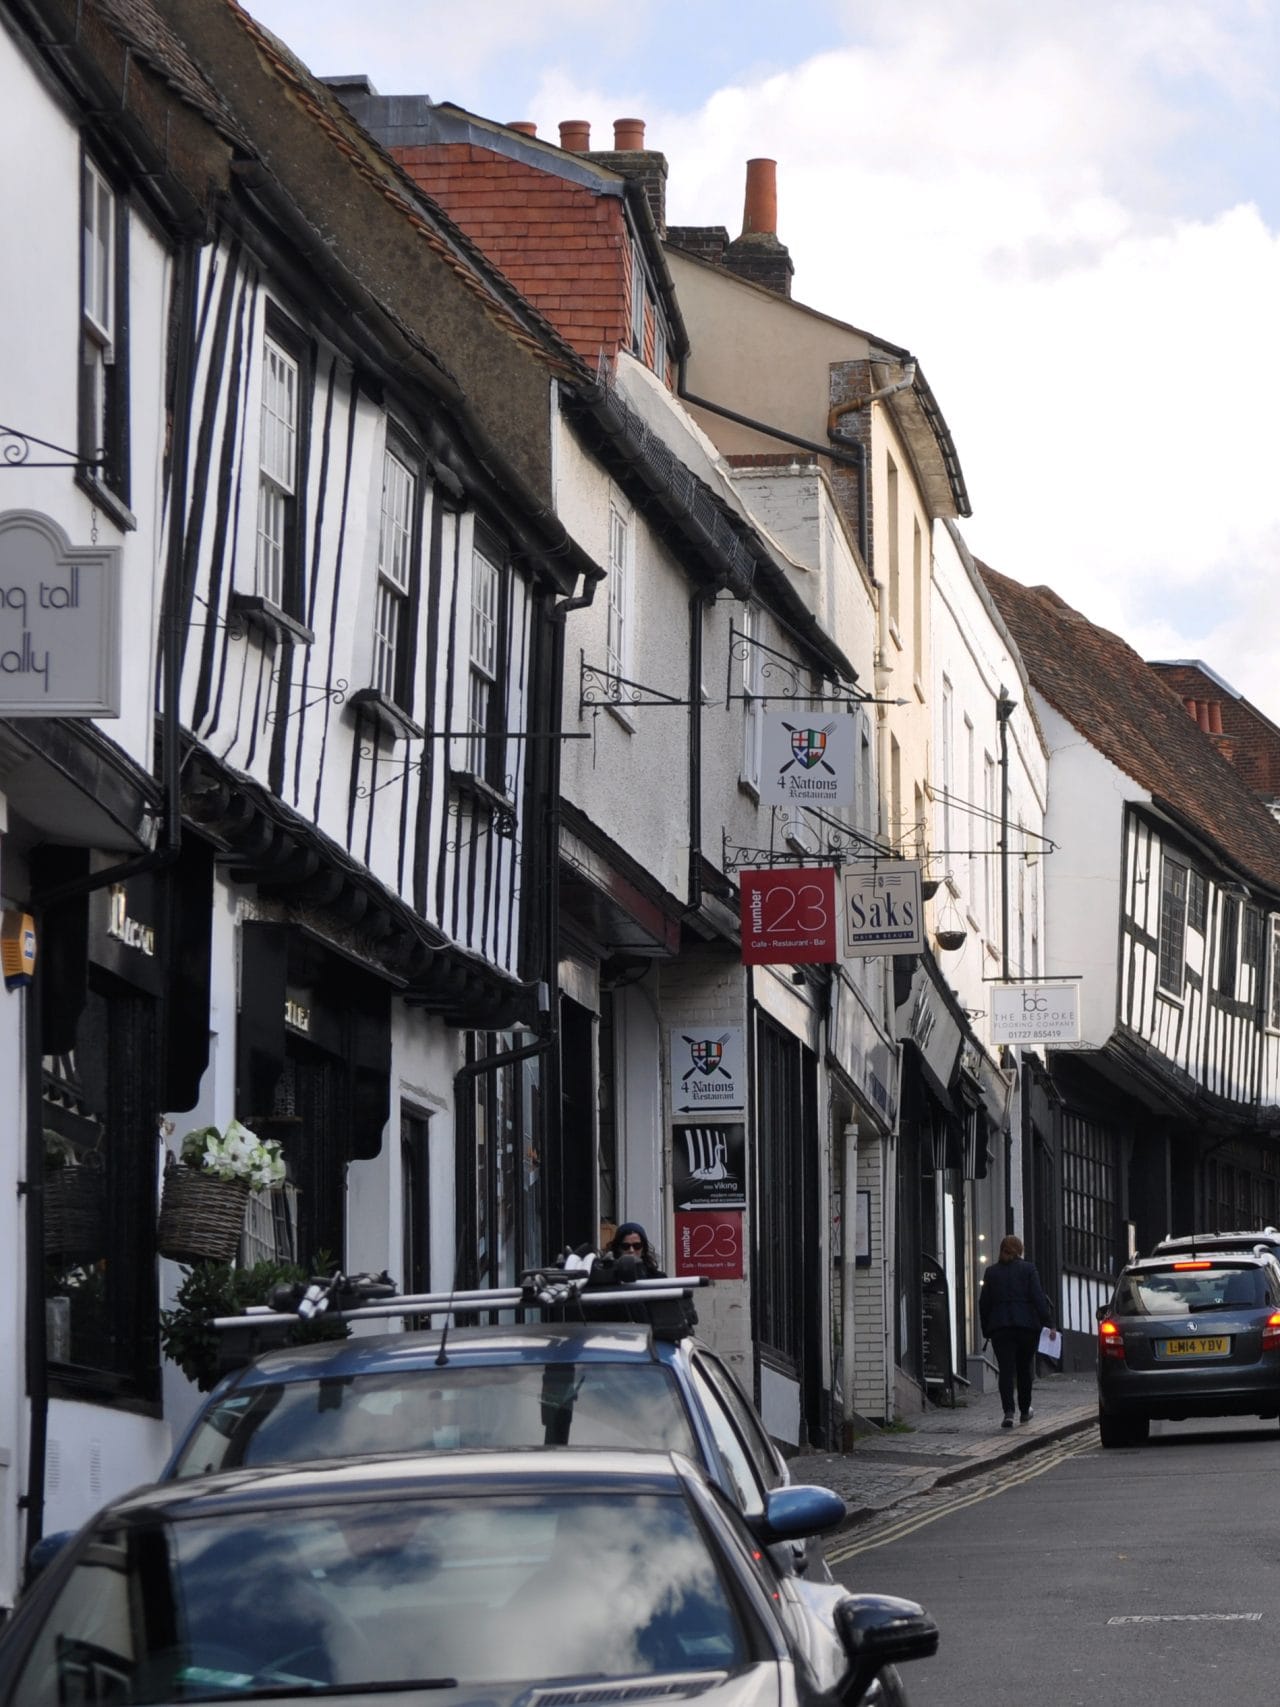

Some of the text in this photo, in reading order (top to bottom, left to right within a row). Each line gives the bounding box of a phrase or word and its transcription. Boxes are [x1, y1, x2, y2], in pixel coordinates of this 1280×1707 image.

[39, 566, 79, 609] tall
[0, 631, 49, 693] ally
[777, 775, 838, 790] 4 Nations
[788, 789, 837, 799] Restaurant
[750, 885, 827, 933] number 23
[851, 892, 914, 929] Saks
[772, 939, 809, 947] Restaurant
[813, 938, 826, 946] Bar
[994, 1011, 1075, 1021] THE BESPOKE
[1033, 1030, 1062, 1038] 855419
[681, 1080, 734, 1093] 4 Nations
[692, 1092, 734, 1100] Restaurant
[682, 1223, 737, 1258] number 23
